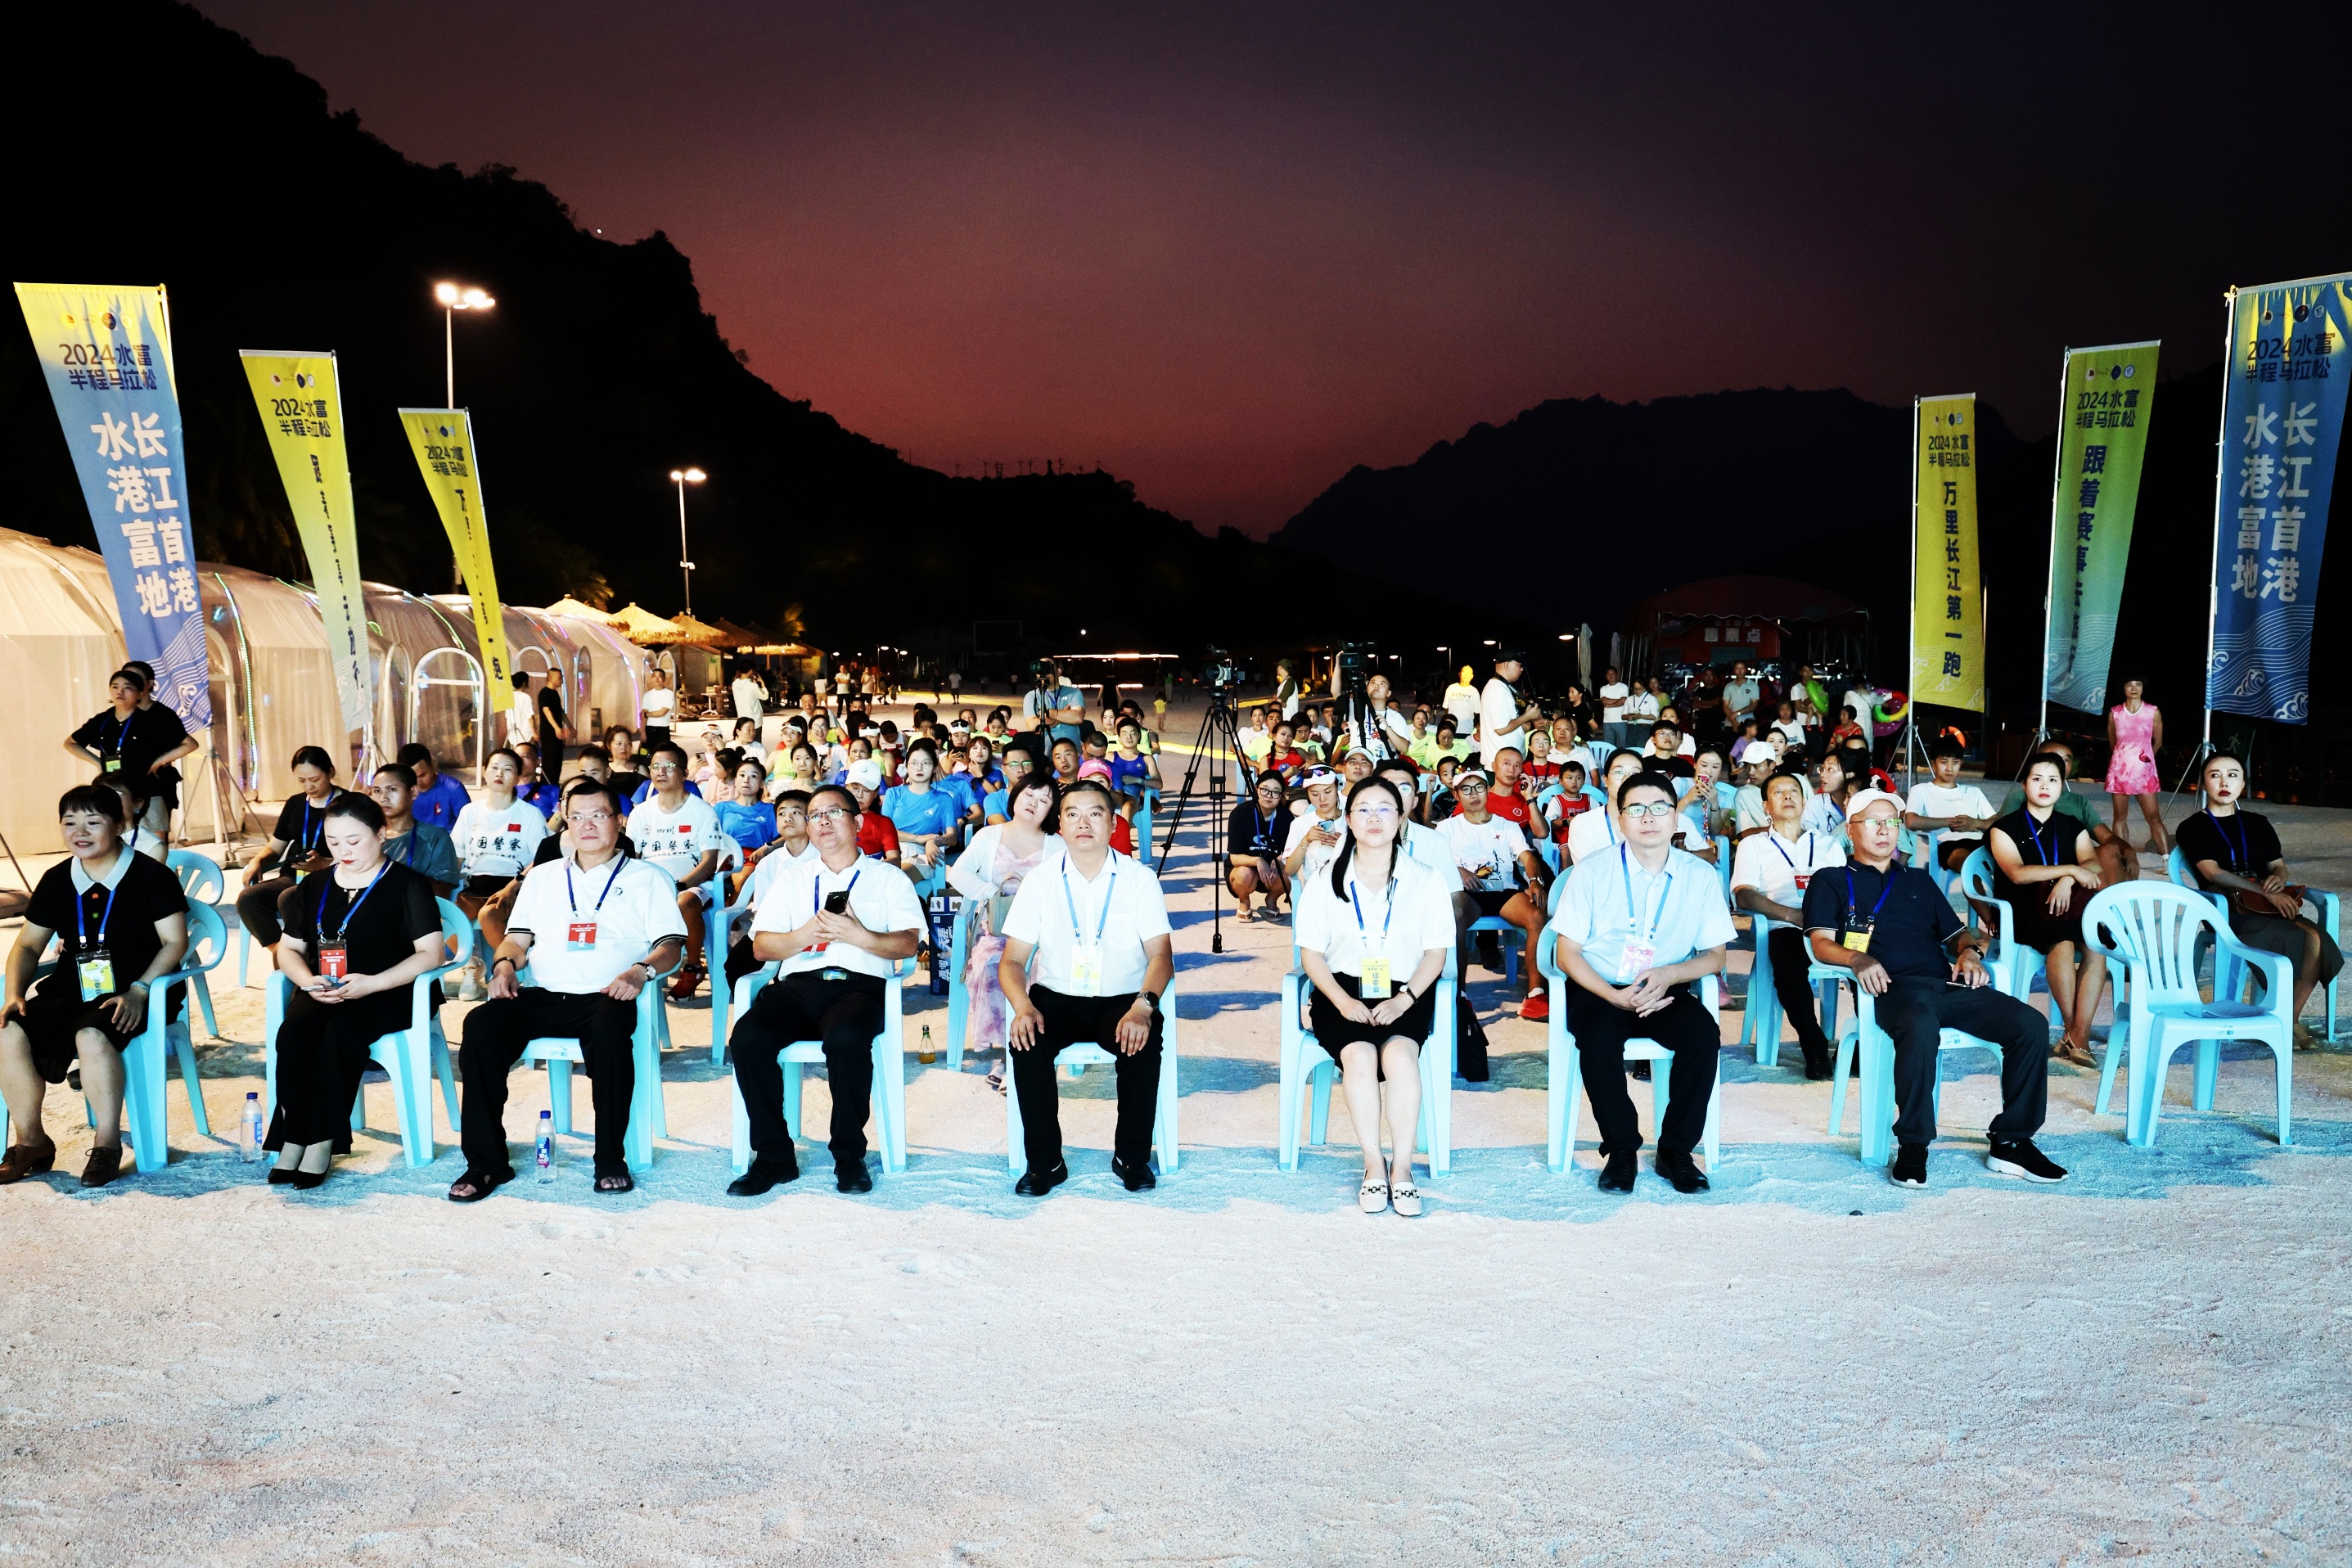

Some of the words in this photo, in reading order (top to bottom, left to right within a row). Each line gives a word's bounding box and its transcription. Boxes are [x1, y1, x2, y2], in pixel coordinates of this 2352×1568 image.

[59, 343, 152, 366] 2024水富
[68, 368, 157, 390] 半程马拉松
[2077, 389, 2140, 410] 2024水富
[2246, 331, 2336, 361] 2024水富
[2246, 357, 2331, 384] 半程马拉松
[91, 412, 173, 619] 水港富地
[132, 411, 198, 613] 长江首港
[2232, 402, 2278, 601] 水港富地
[2260, 401, 2318, 603] 长江首港
[1942, 481, 1962, 678] 万里长江第一跑
